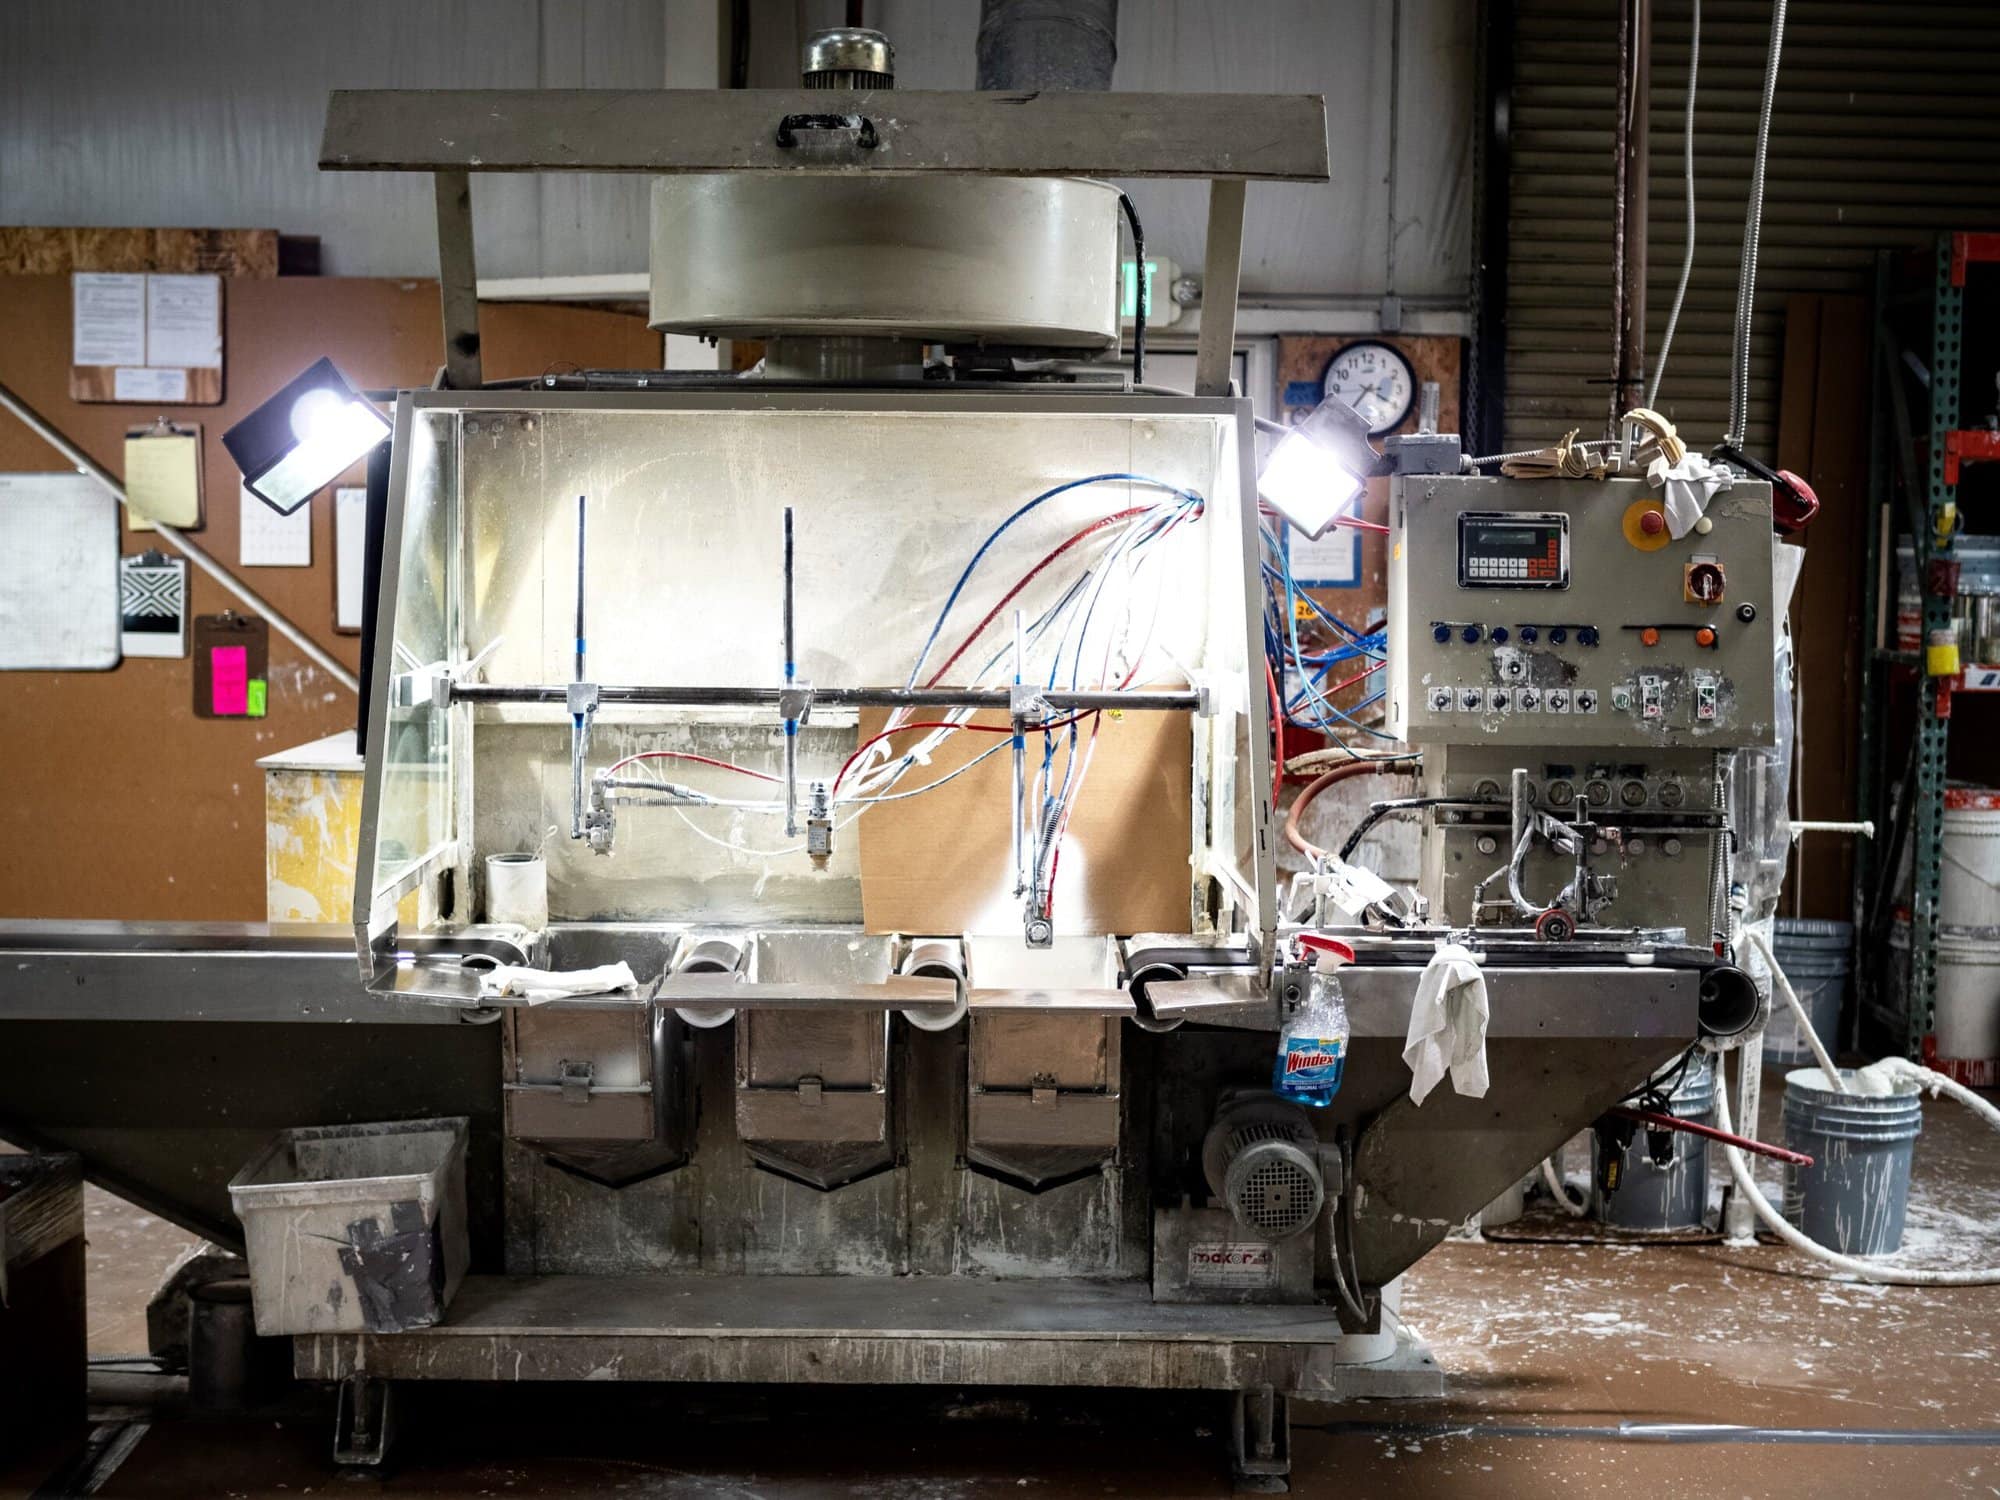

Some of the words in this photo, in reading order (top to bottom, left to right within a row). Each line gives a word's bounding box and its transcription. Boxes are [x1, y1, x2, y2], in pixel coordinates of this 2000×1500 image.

[1348, 358, 1358, 368] 11
[1361, 352, 1375, 364] 12
[1381, 359, 1386, 368] 1
[1336, 369, 1349, 380] 10
[1391, 369, 1398, 379] 2
[1332, 383, 1340, 393] 9
[1298, 606, 1313, 616] 26
[1286, 1052, 1336, 1074] Windex
